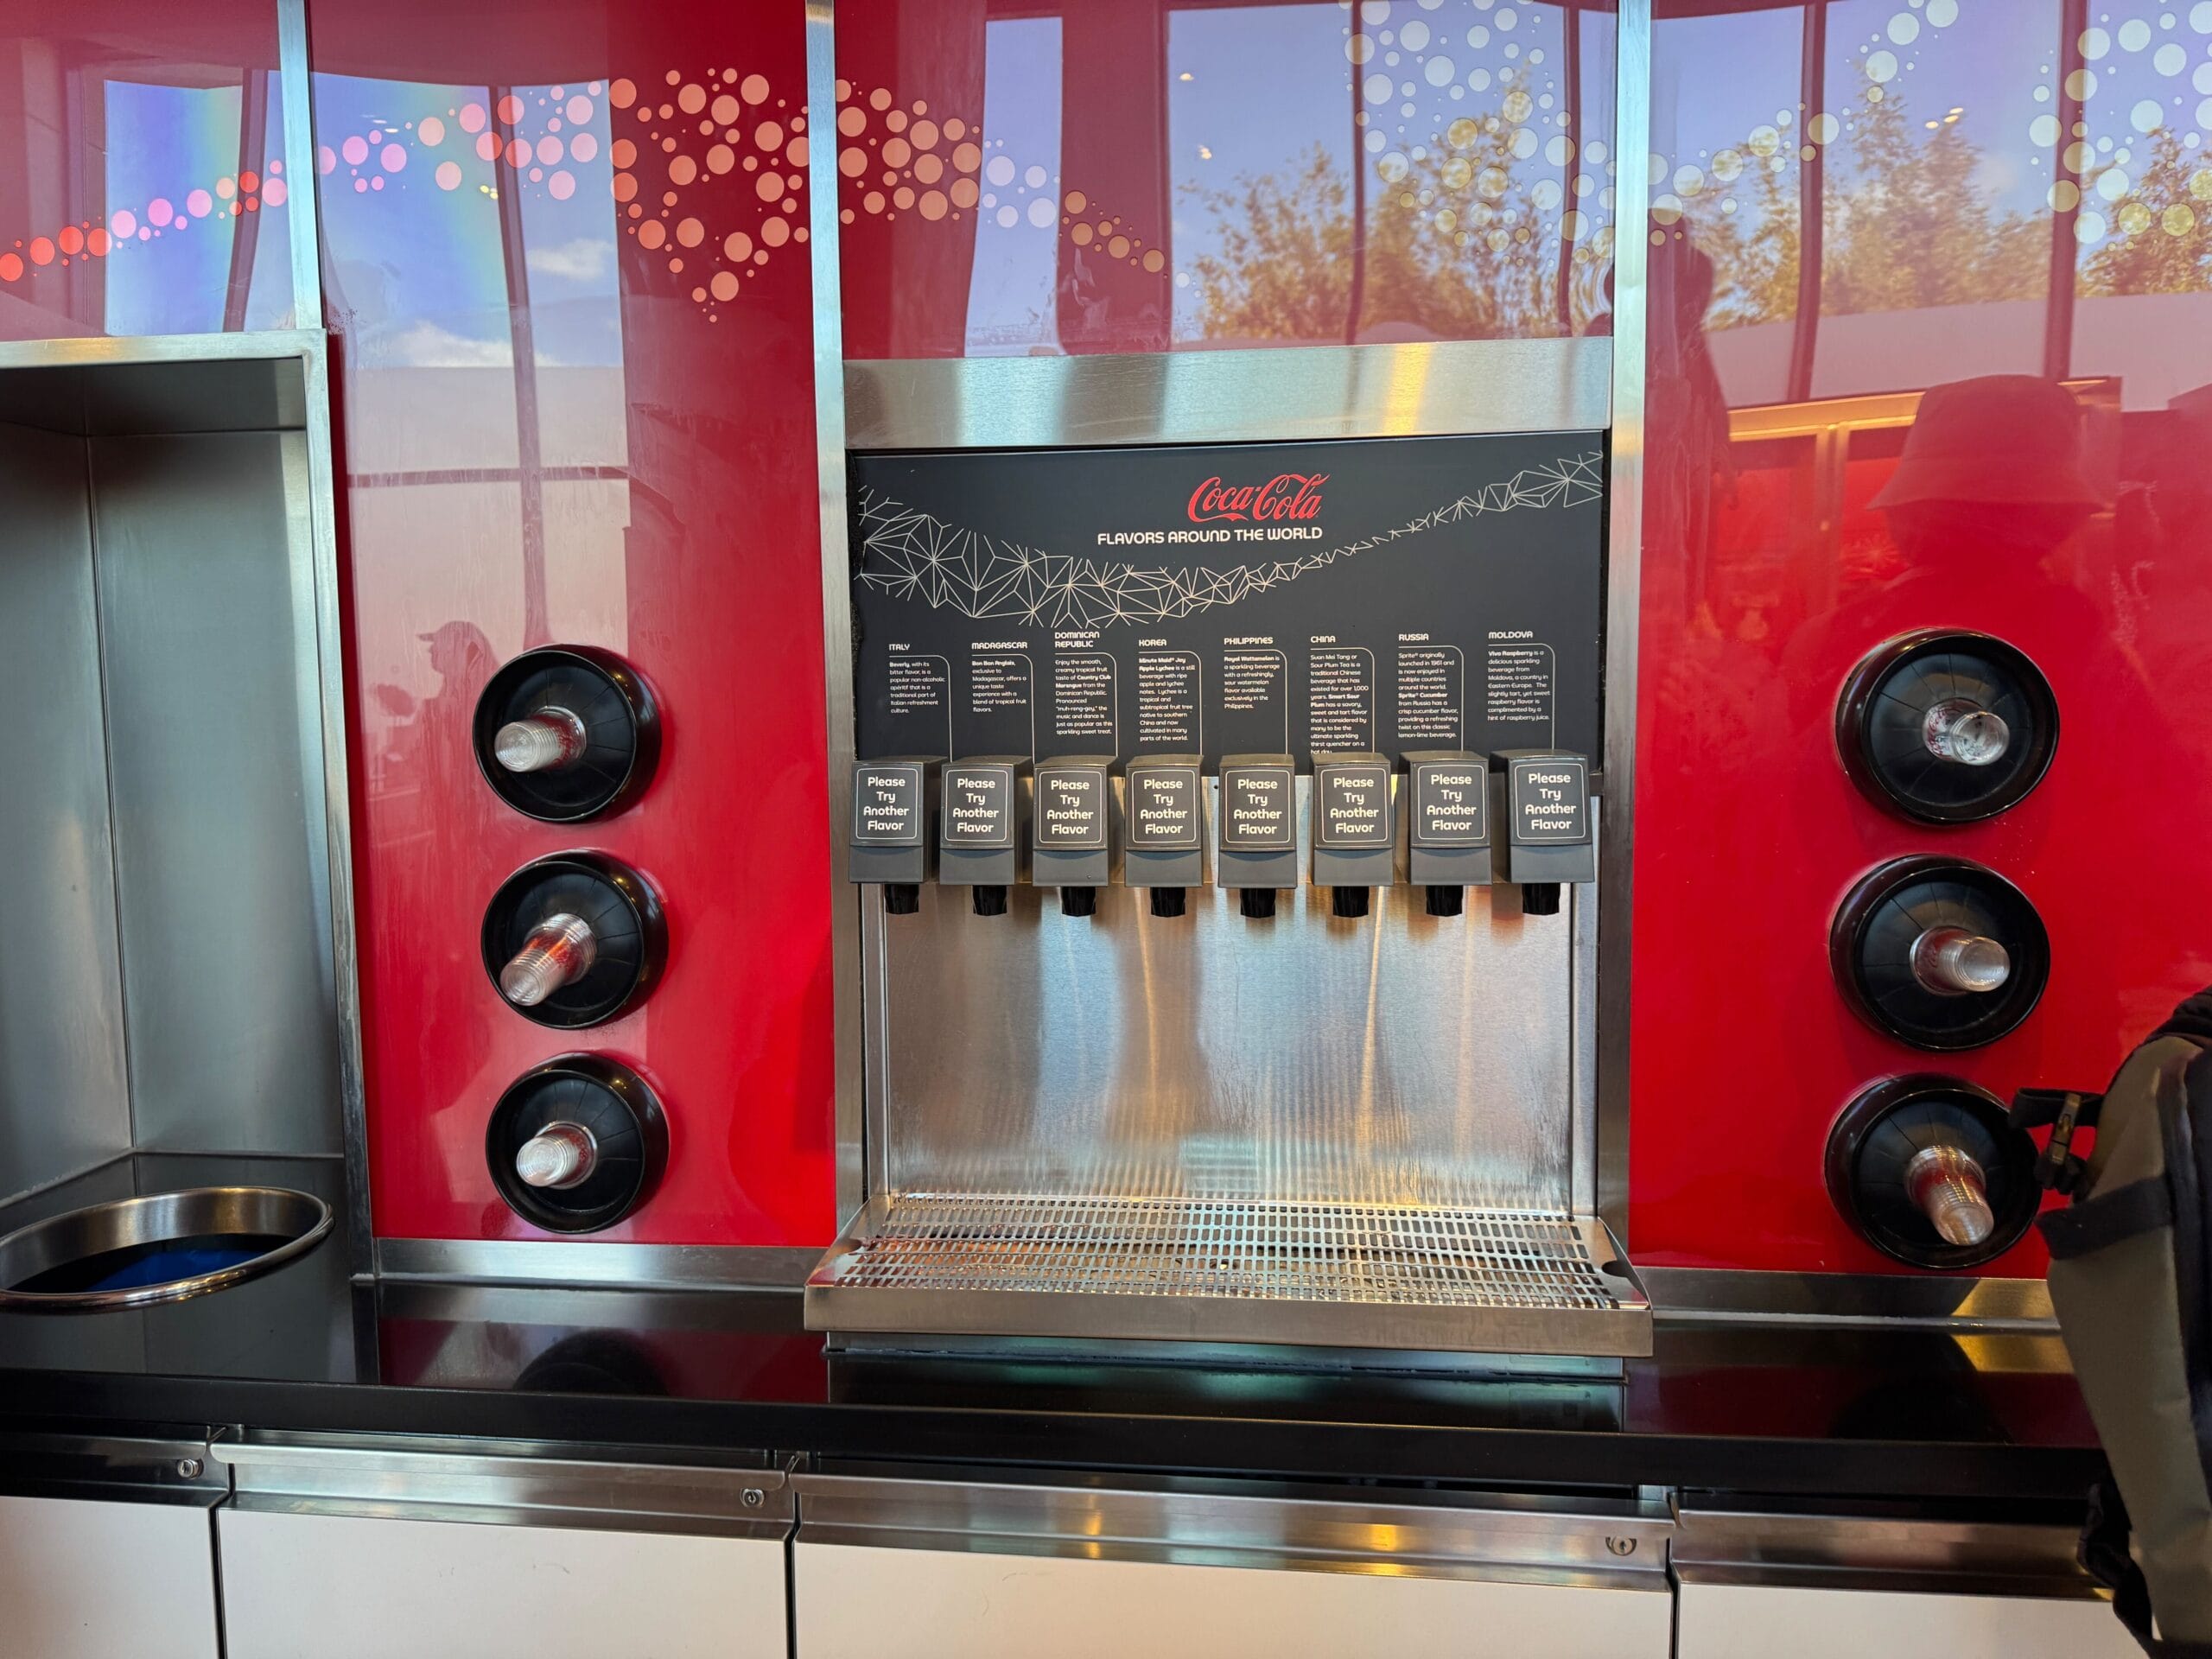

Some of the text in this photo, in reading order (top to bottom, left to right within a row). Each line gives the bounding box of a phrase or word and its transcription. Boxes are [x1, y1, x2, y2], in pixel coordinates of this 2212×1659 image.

[1187, 474, 1330, 523] Coca-Cola
[1098, 527, 1322, 544] FLAVORS AROUND THE WORLD
[868, 776, 906, 786] Please
[957, 778, 995, 788] Please
[1334, 777, 1374, 788] Please
[1431, 774, 1471, 785] Please
[1529, 772, 1571, 784] Please
[1052, 779, 1090, 790] Please
[1144, 779, 1183, 789] Please
[1238, 779, 1278, 789] Please
[876, 791, 895, 804] Try
[966, 793, 985, 805] Try
[1154, 794, 1173, 806] Try
[1248, 794, 1268, 806] Try
[1344, 792, 1364, 804] Try
[1441, 790, 1462, 802] Try
[1540, 789, 1560, 801] Try
[1060, 795, 1079, 807] Try
[864, 805, 909, 816] Another
[953, 807, 999, 817] Another
[1047, 809, 1094, 819] Another
[1141, 808, 1187, 819] Another
[1234, 809, 1282, 819] Another
[1331, 807, 1379, 818] Another
[1427, 804, 1477, 815] Another
[1525, 803, 1576, 815] Another
[868, 820, 904, 830] Flavor
[957, 822, 994, 832] Flavor
[1052, 824, 1089, 834] Flavor
[1146, 823, 1183, 834] Flavor
[1239, 823, 1277, 834] Flavor
[1336, 823, 1374, 833] Flavor
[1433, 820, 1471, 830] Flavor
[1531, 819, 1572, 830] Flavor
